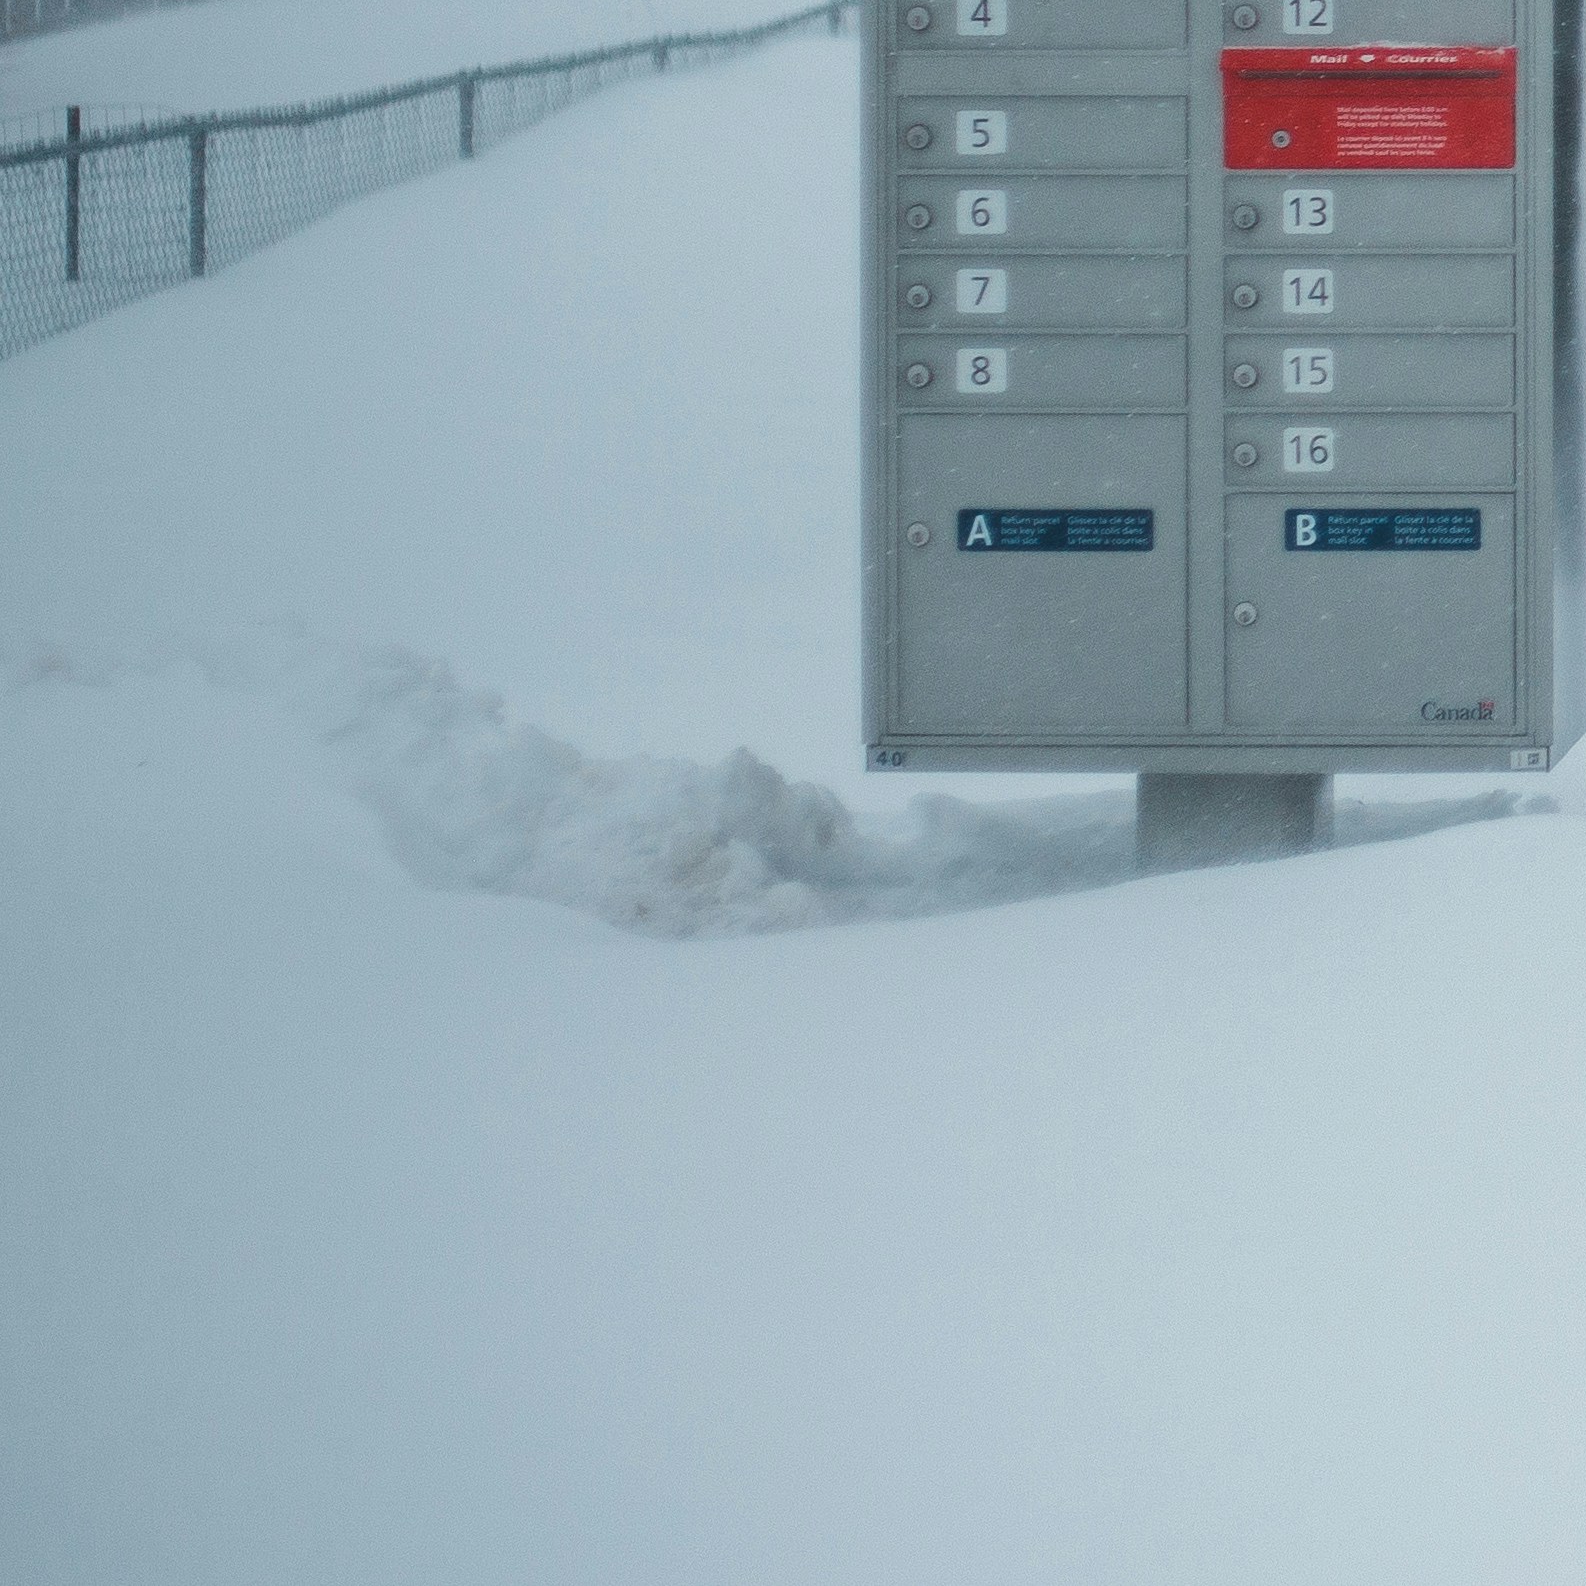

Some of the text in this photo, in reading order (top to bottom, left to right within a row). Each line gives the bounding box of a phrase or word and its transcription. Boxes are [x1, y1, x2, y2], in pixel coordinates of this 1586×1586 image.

[1310, 55, 1348, 63] Mail
[972, 117, 990, 148] 5
[970, 196, 991, 228] 6
[1289, 196, 1328, 227] 13
[971, 276, 990, 306] 7
[1289, 276, 1330, 307] 14
[970, 355, 992, 386] 8
[1289, 355, 1328, 386] 15
[1289, 434, 1329, 465] 16
[965, 514, 993, 546] A
[1296, 514, 1317, 546] B
[1421, 701, 1494, 721] Canada
